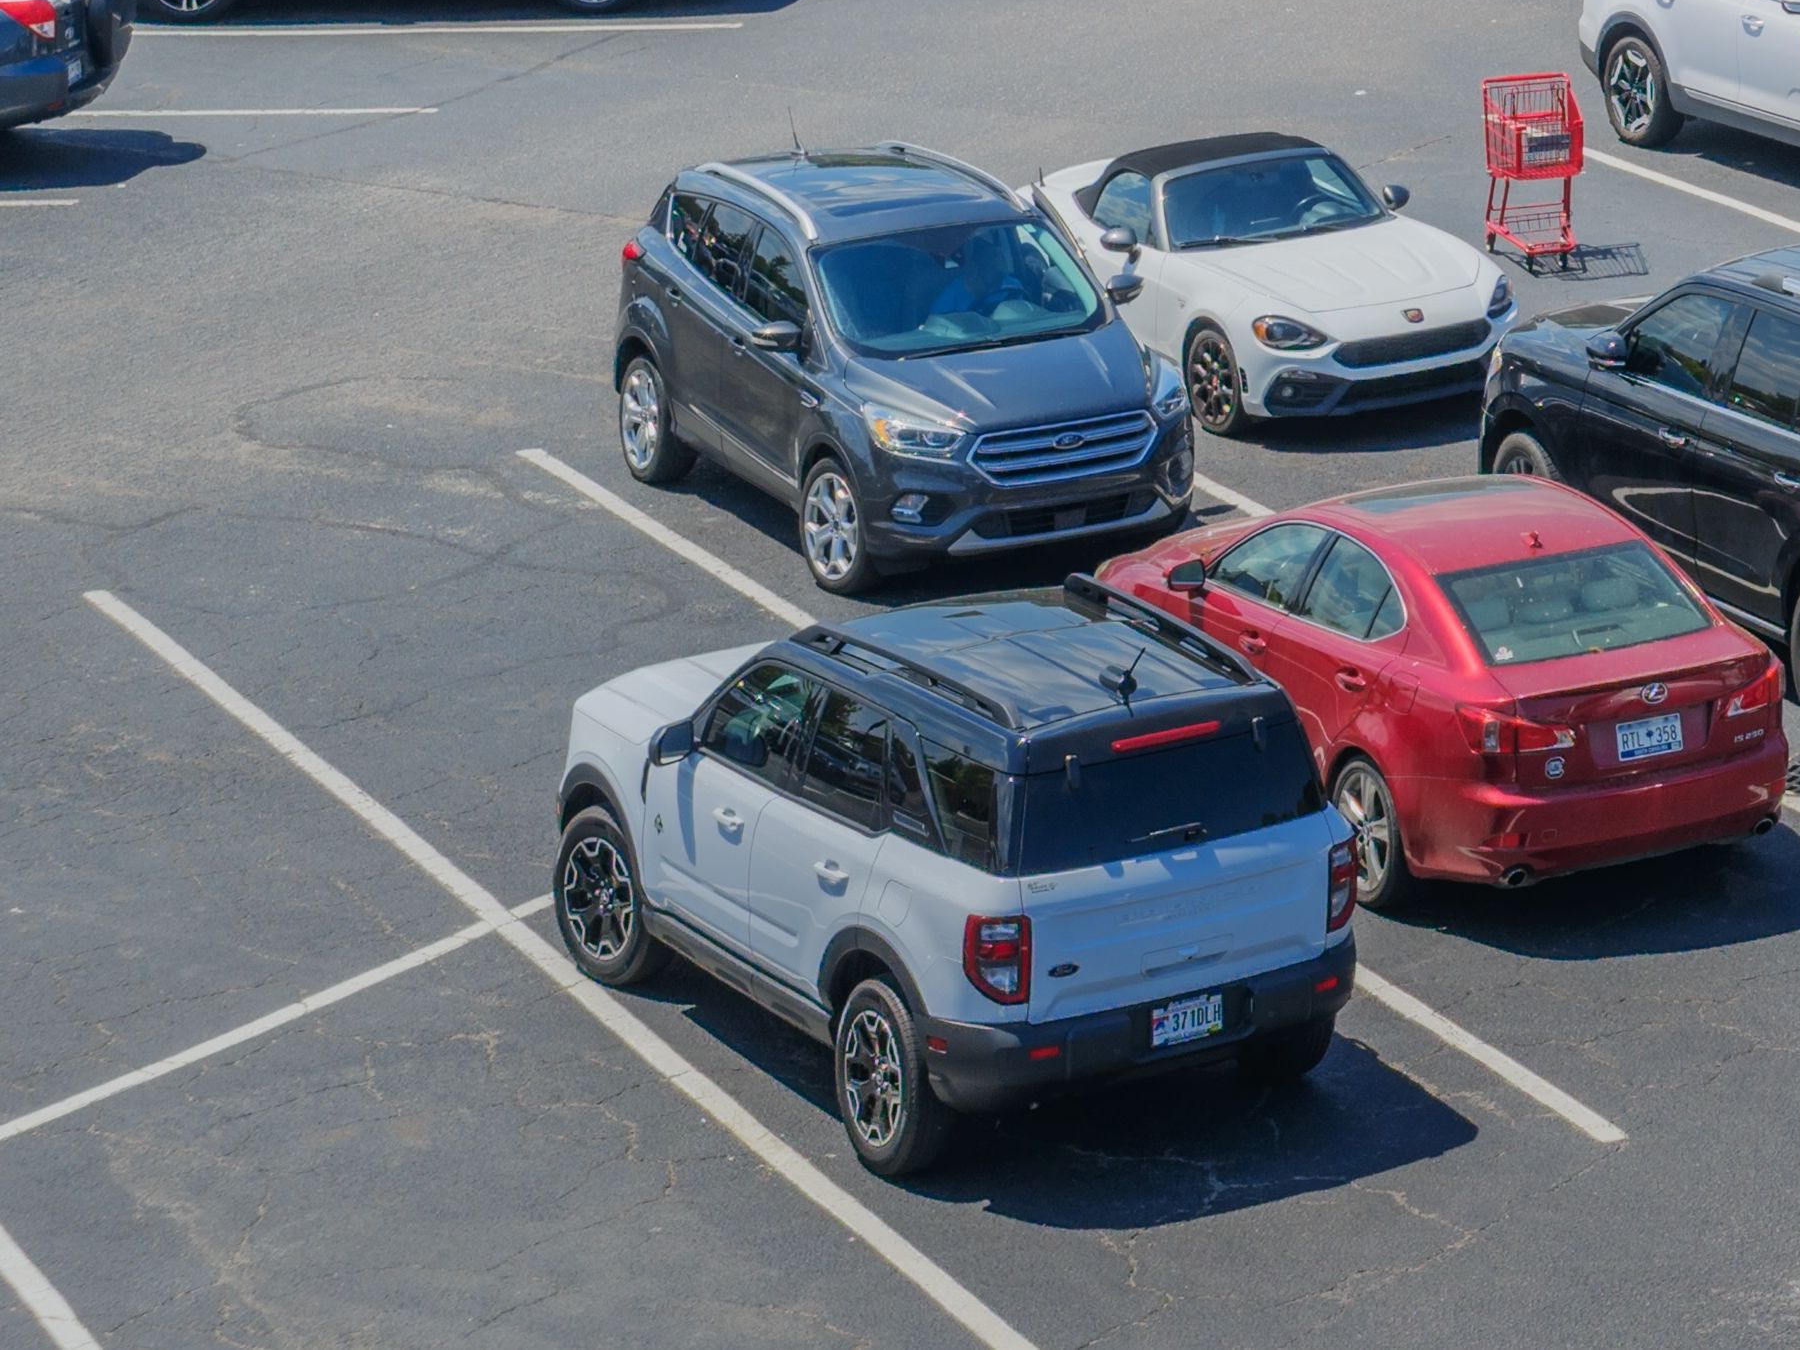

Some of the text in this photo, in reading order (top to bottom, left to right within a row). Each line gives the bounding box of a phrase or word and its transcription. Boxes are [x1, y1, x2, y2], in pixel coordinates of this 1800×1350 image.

[1621, 724, 1678, 751] RTL 358
[1171, 1002, 1222, 1033] 371DLH
